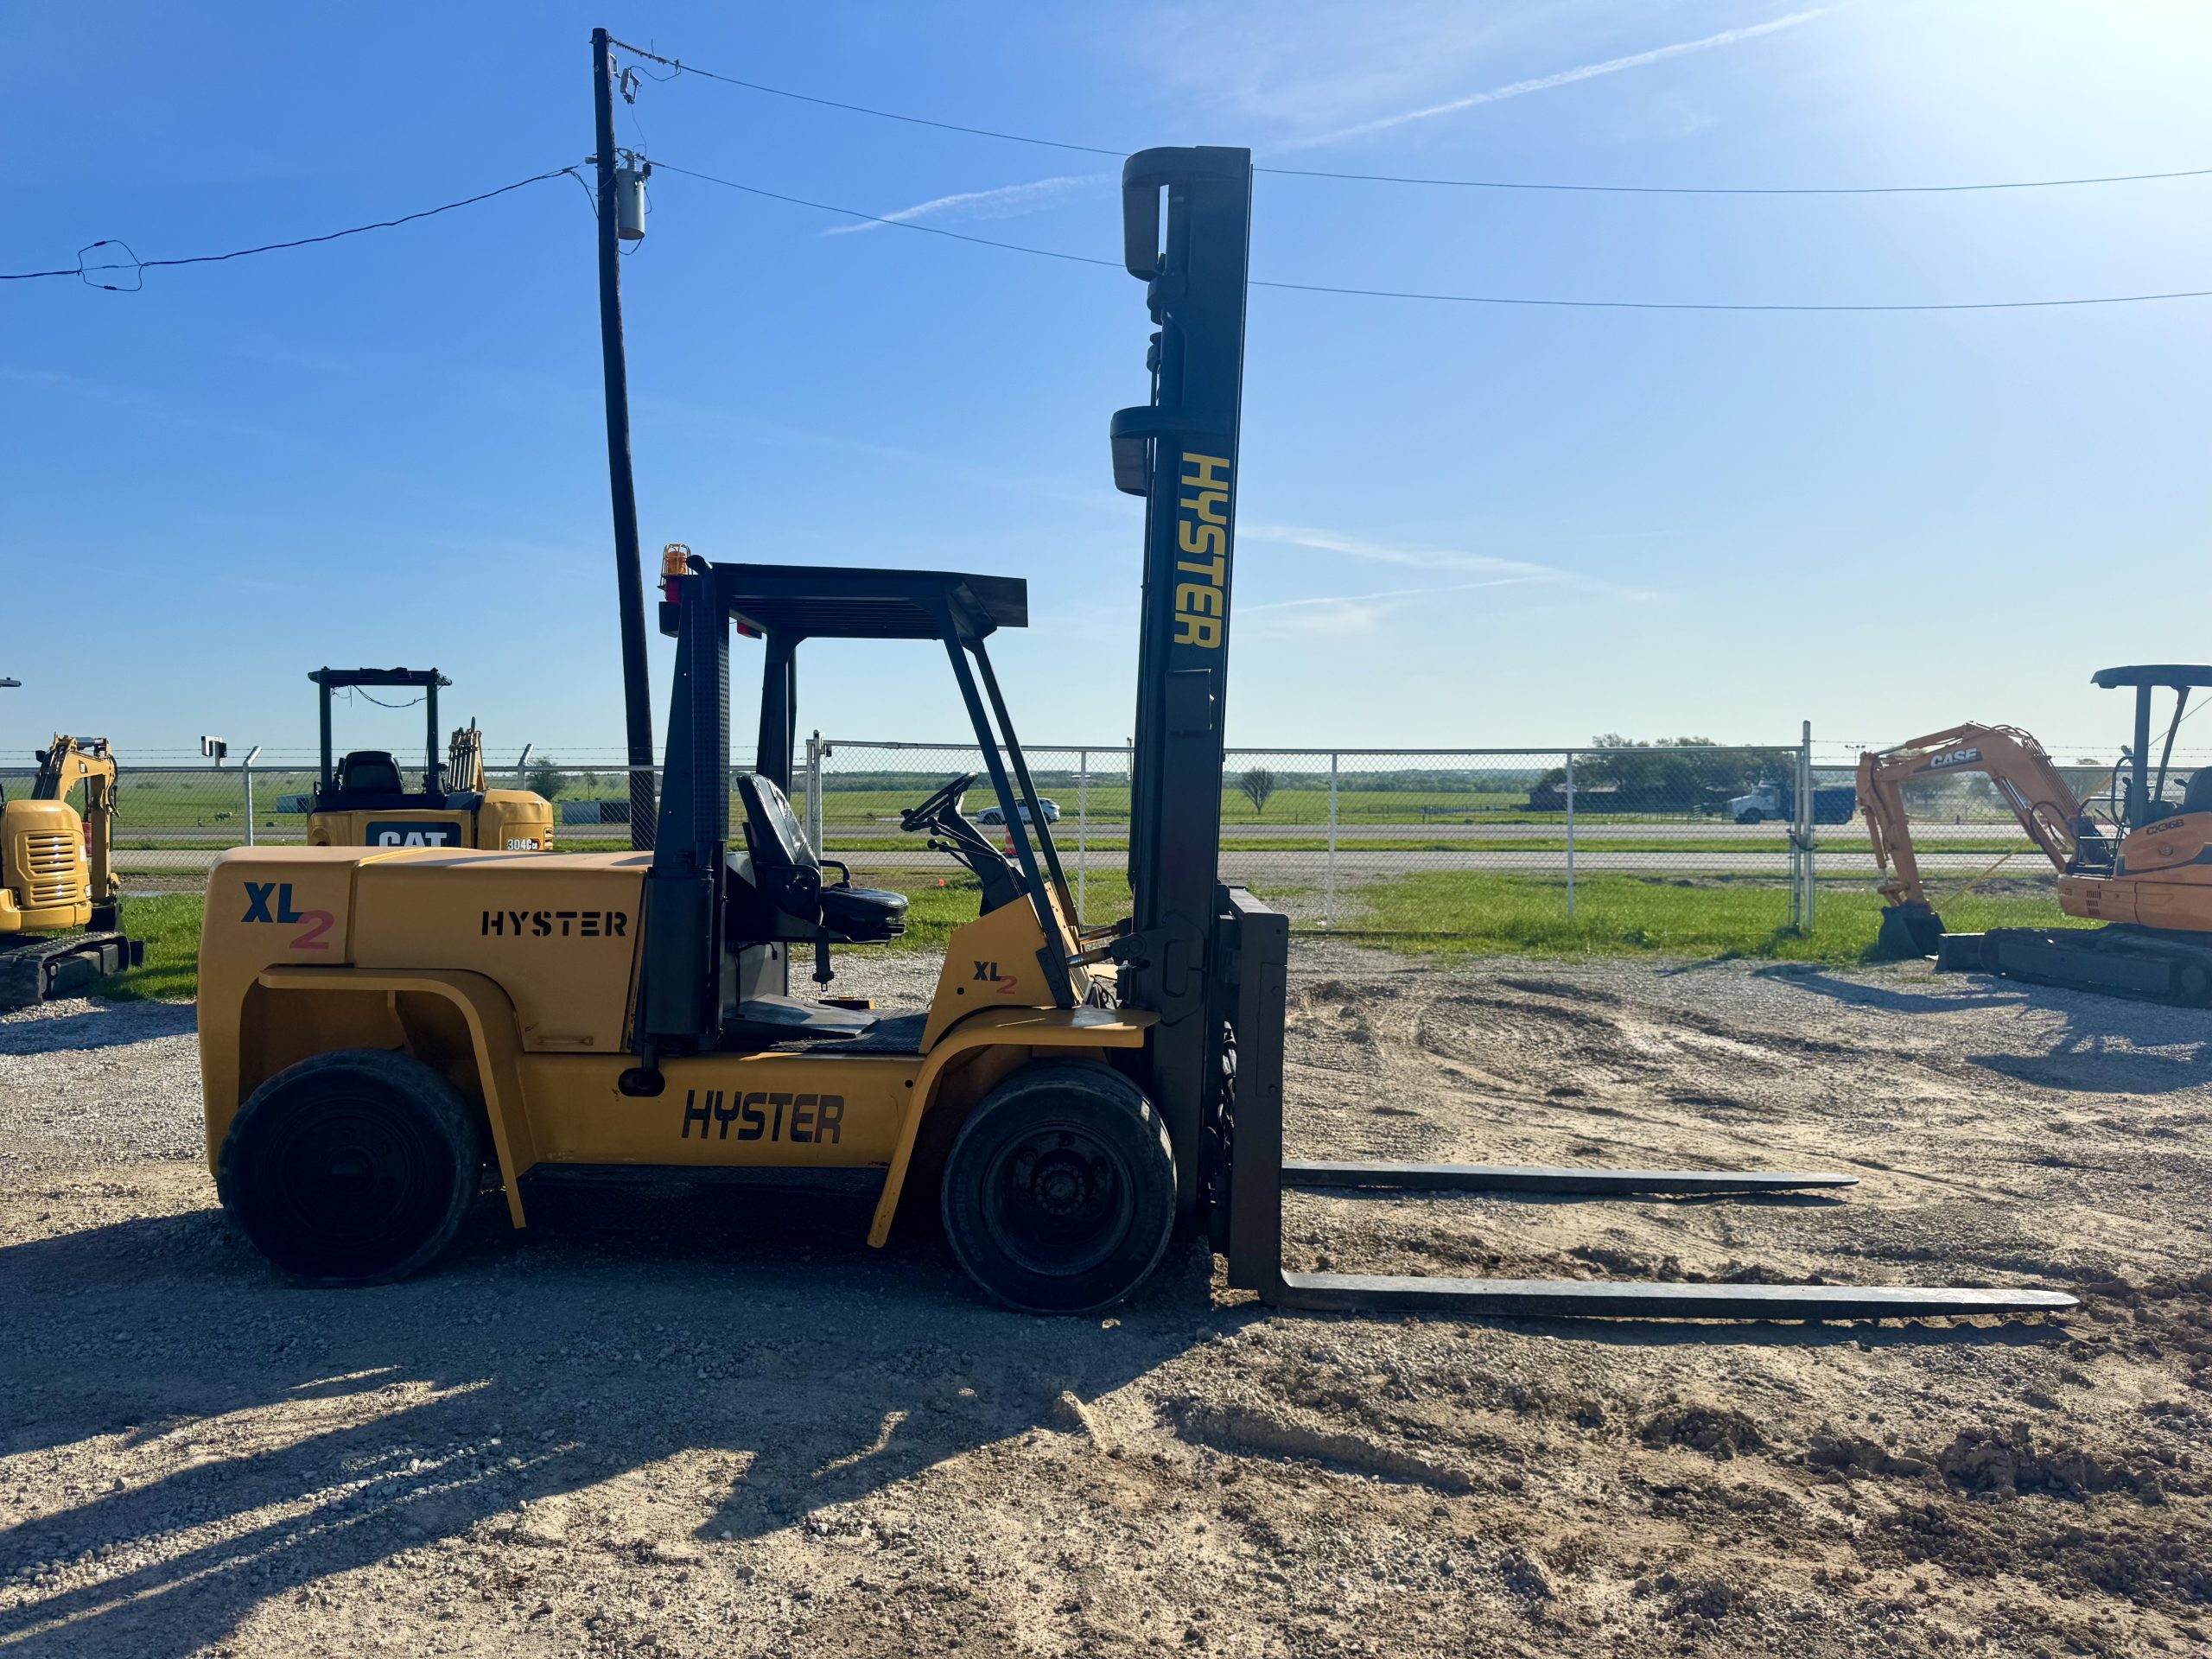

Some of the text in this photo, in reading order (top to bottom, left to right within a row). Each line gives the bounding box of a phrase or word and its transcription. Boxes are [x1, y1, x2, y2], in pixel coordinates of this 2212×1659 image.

[1173, 452, 1230, 649] HYSTER
[1929, 747, 1978, 769] CASE
[481, 911, 628, 937] HYSTER
[681, 1089, 845, 1144] HYSTER
